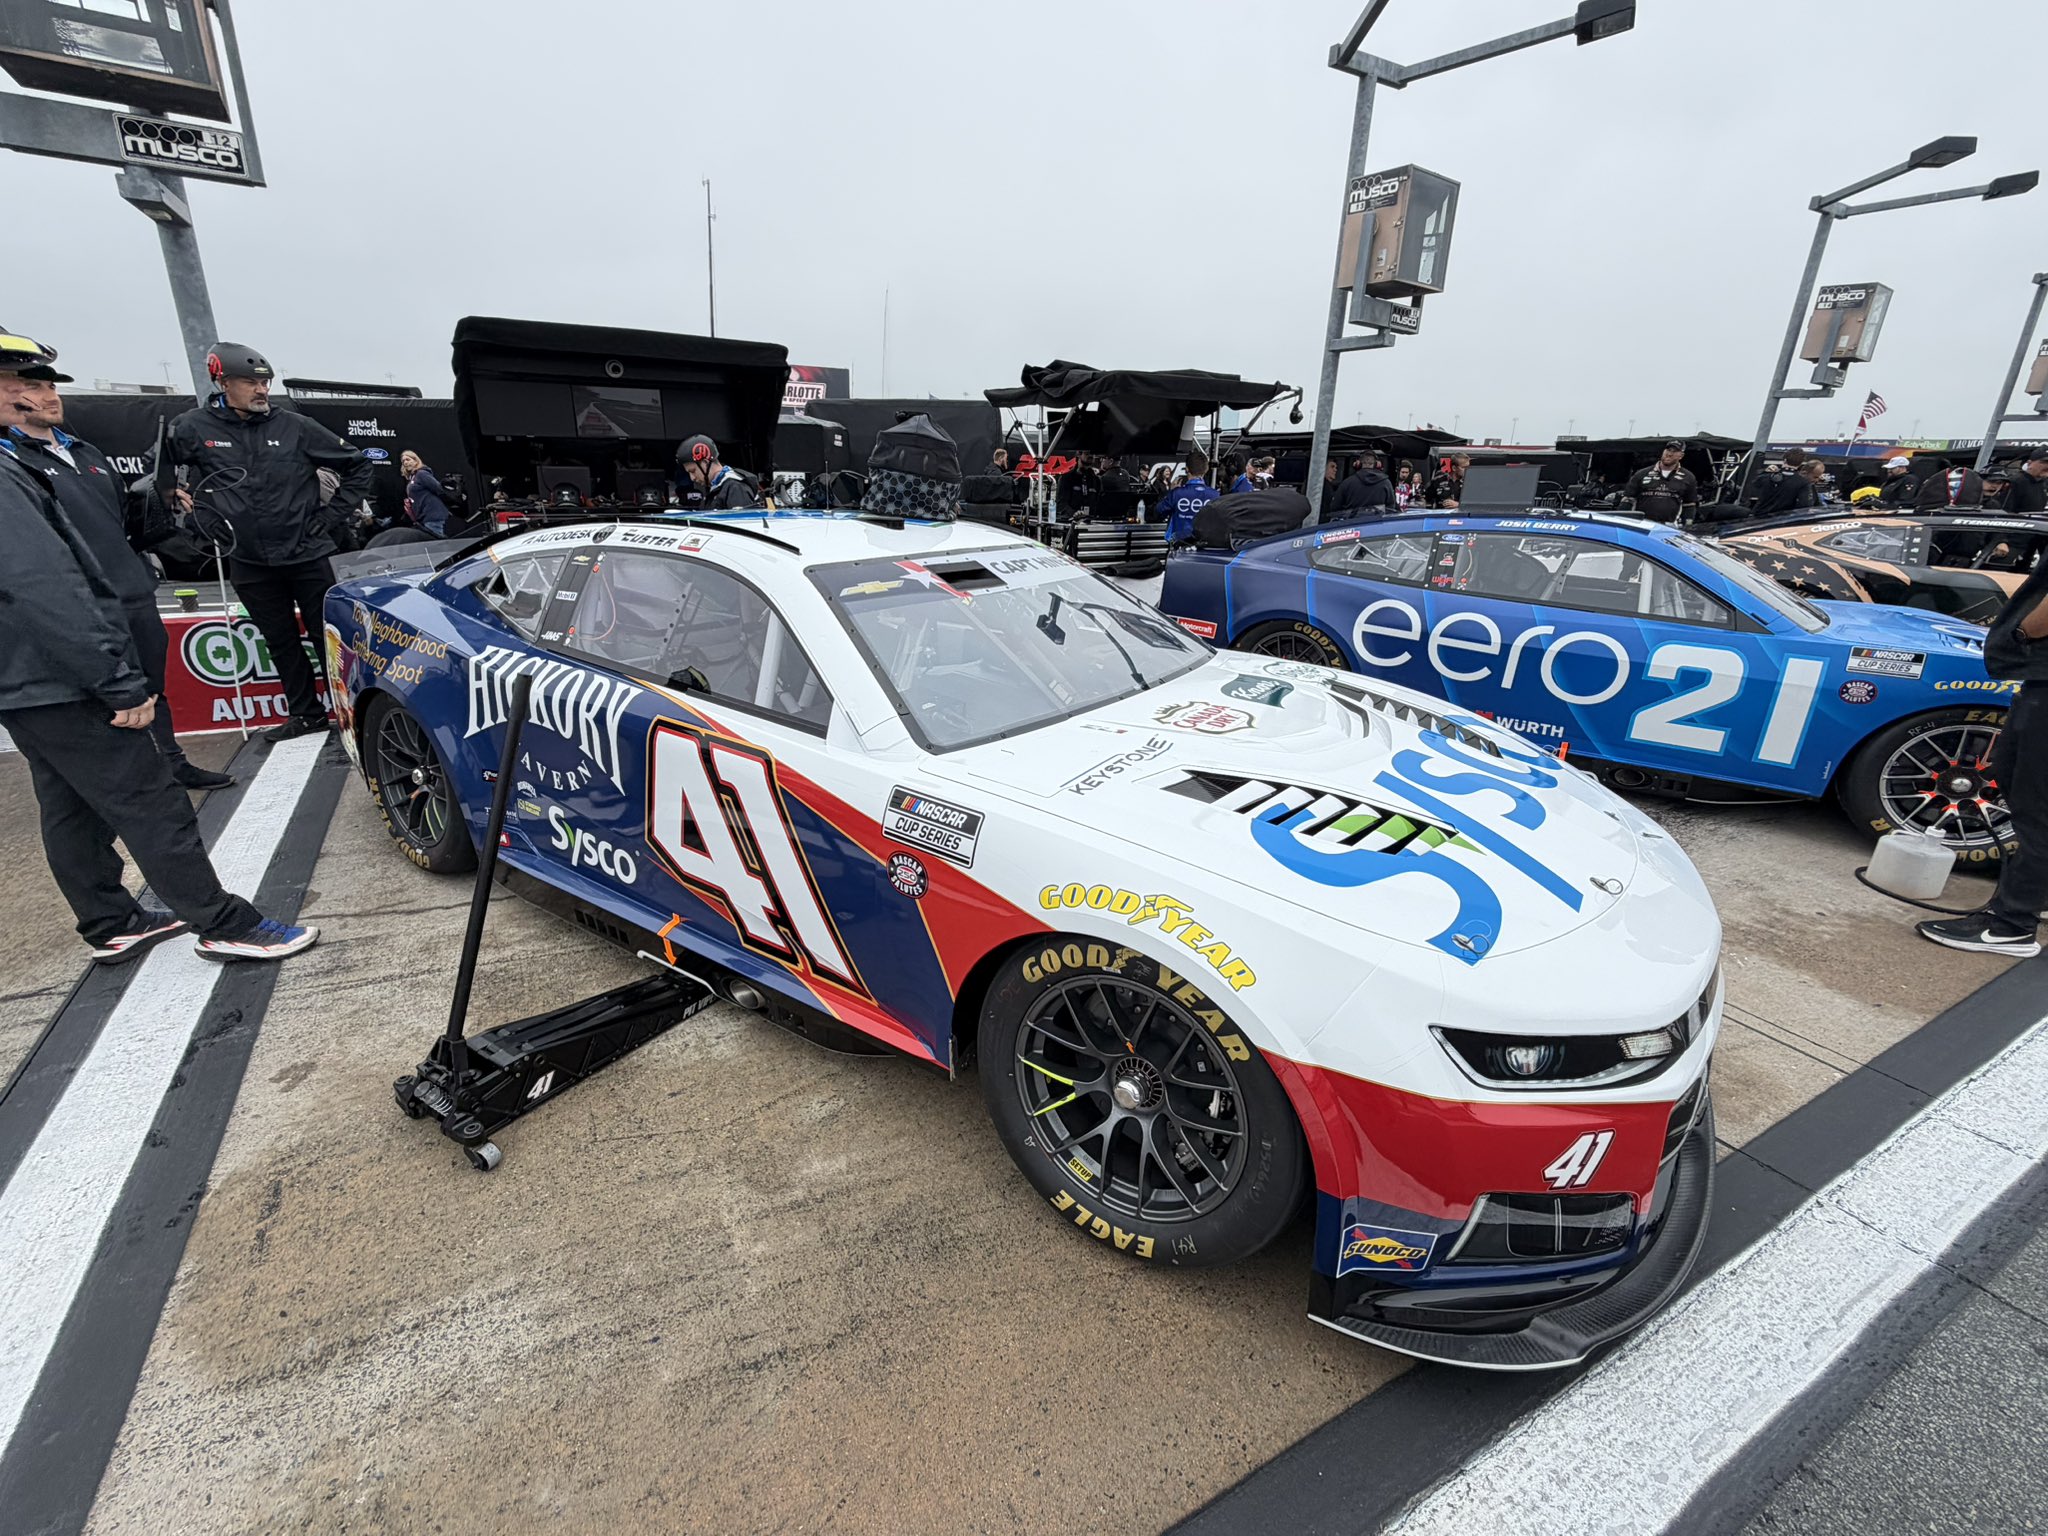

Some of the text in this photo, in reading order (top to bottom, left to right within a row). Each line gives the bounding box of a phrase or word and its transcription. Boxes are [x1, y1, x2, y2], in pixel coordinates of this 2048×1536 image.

[1495, 519, 1580, 531] JOSH BERRY
[1952, 518, 2026, 528] STENHOUSE
[536, 528, 595, 543] AUTODESK
[989, 558, 1038, 574] CAPT
[370, 611, 448, 660] Neighborhood
[1180, 621, 1213, 634] Motorcraft
[352, 631, 425, 685] Gathering Spot
[1353, 599, 1630, 705] eero
[1873, 650, 1916, 662] NASCAR
[1857, 660, 1913, 673] CUP SERIES
[211, 693, 290, 722] AUTO
[1172, 704, 1231, 728] CANADA
[1627, 642, 1826, 767] 21
[1206, 712, 1241, 728] DRY
[1496, 715, 1565, 738] WÜRTH
[1068, 736, 1168, 796] KEYSTONE
[914, 799, 968, 829] NASCAR
[895, 817, 962, 850] CUP SERIES
[648, 722, 866, 998] 41
[892, 855, 923, 875] NASCAR
[890, 874, 923, 896] SALUTES
[897, 868, 918, 882] 250
[1038, 882, 1258, 992] GOODYEAR
[527, 1070, 555, 1100] 41
[1069, 1158, 1093, 1180] SETUP
[1543, 1128, 1615, 1189] 41
[1050, 1188, 1155, 1258] EAGLE
[1343, 1240, 1427, 1260] SUNOCO
